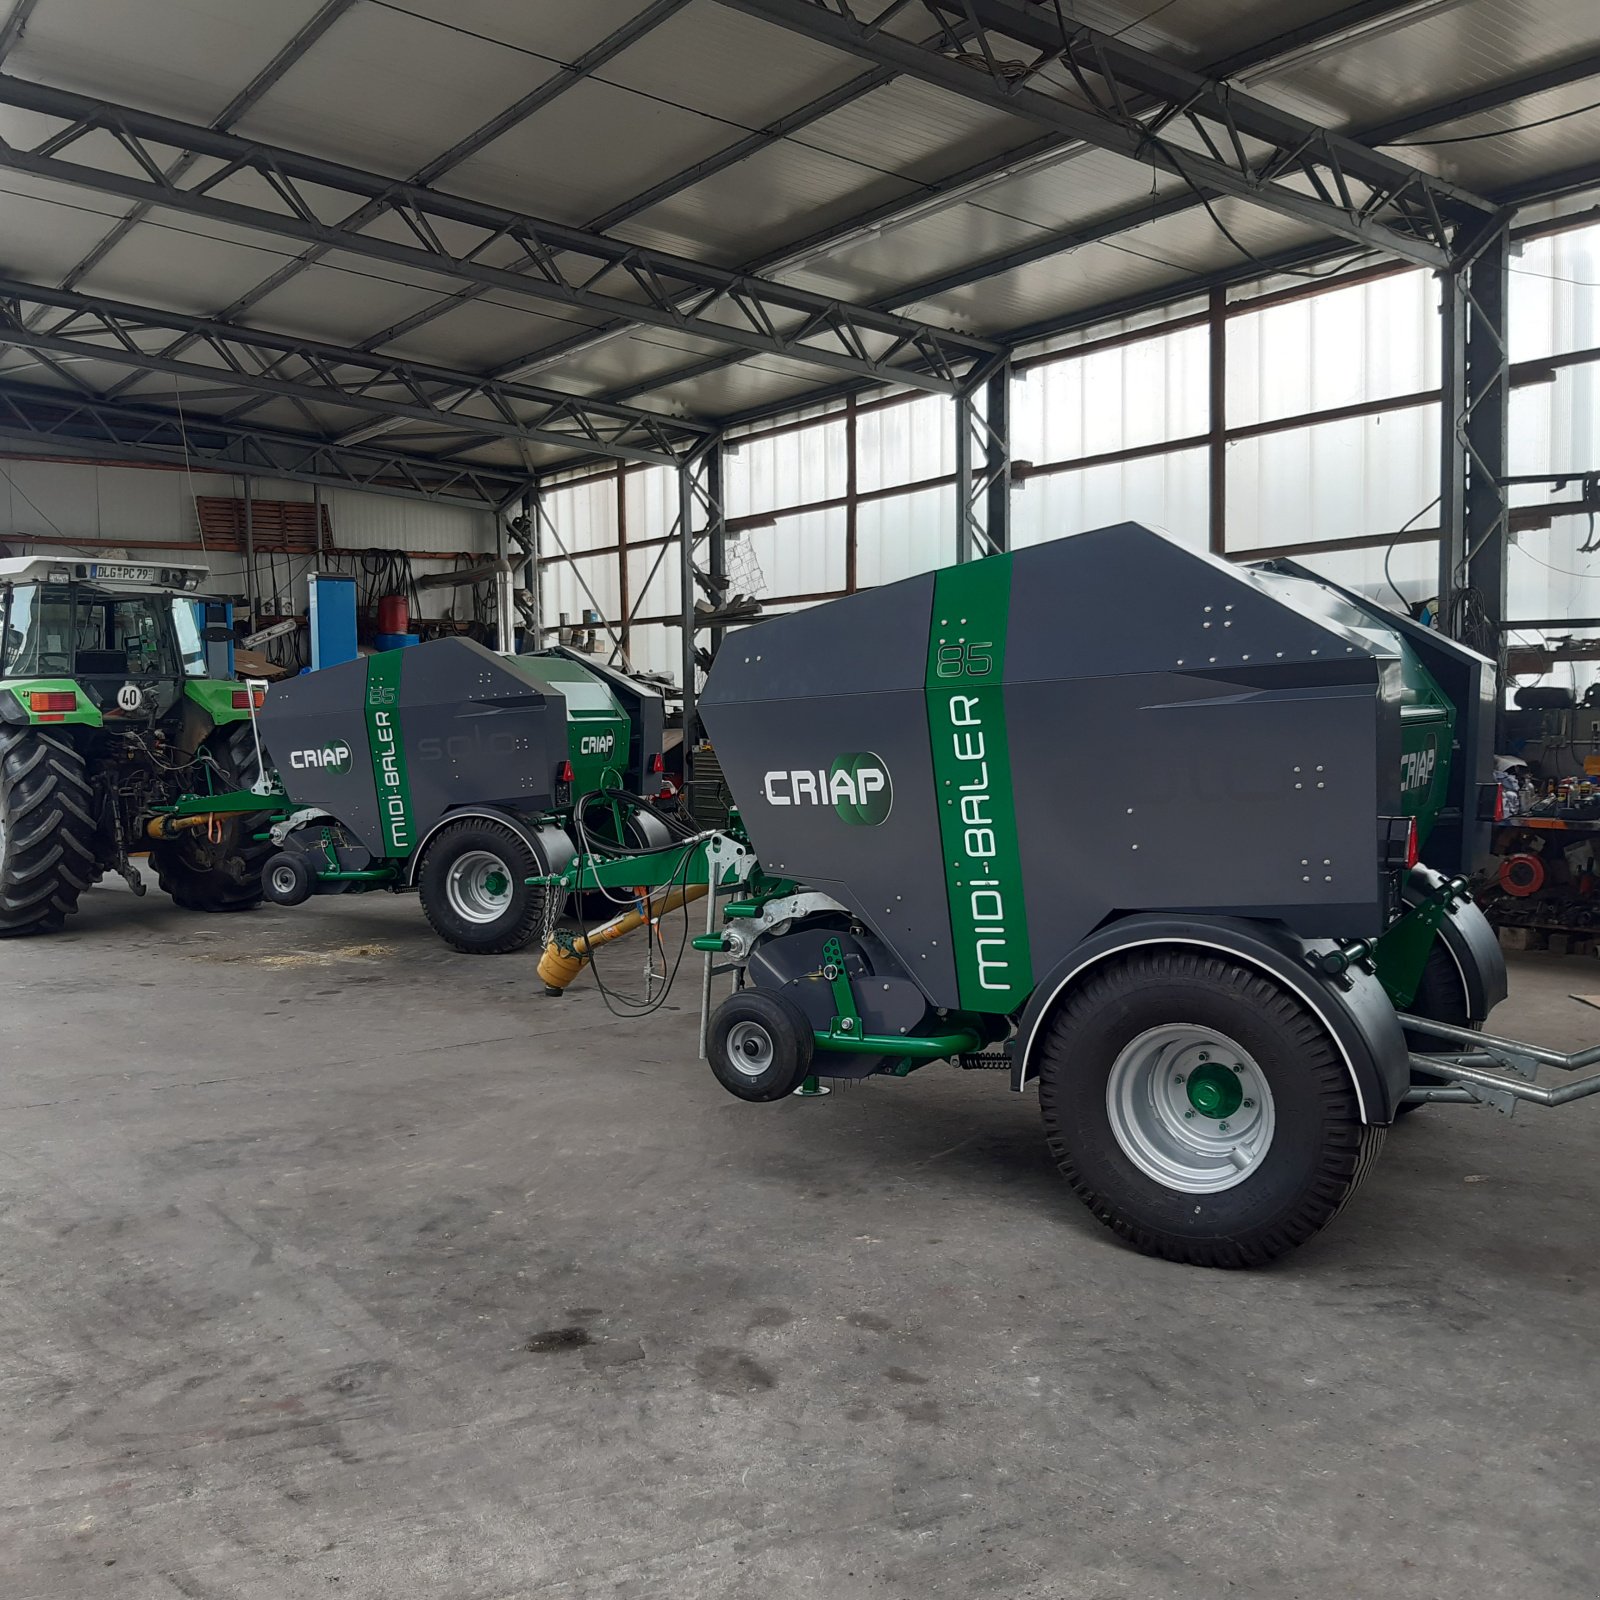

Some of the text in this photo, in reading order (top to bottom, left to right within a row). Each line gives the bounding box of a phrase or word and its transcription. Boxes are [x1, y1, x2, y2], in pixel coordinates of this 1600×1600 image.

[97, 566, 116, 578] DLG
[122, 567, 135, 579] PC
[937, 641, 993, 678] 85
[121, 689, 137, 706] 40
[290, 746, 349, 769] CRIAP
[580, 734, 615, 755] CRIAP
[375, 711, 409, 848] MIDI-BALER
[763, 768, 885, 806] CRIAP
[1400, 748, 1435, 792] CRIAP
[949, 695, 1011, 991] MIDI-BALER
